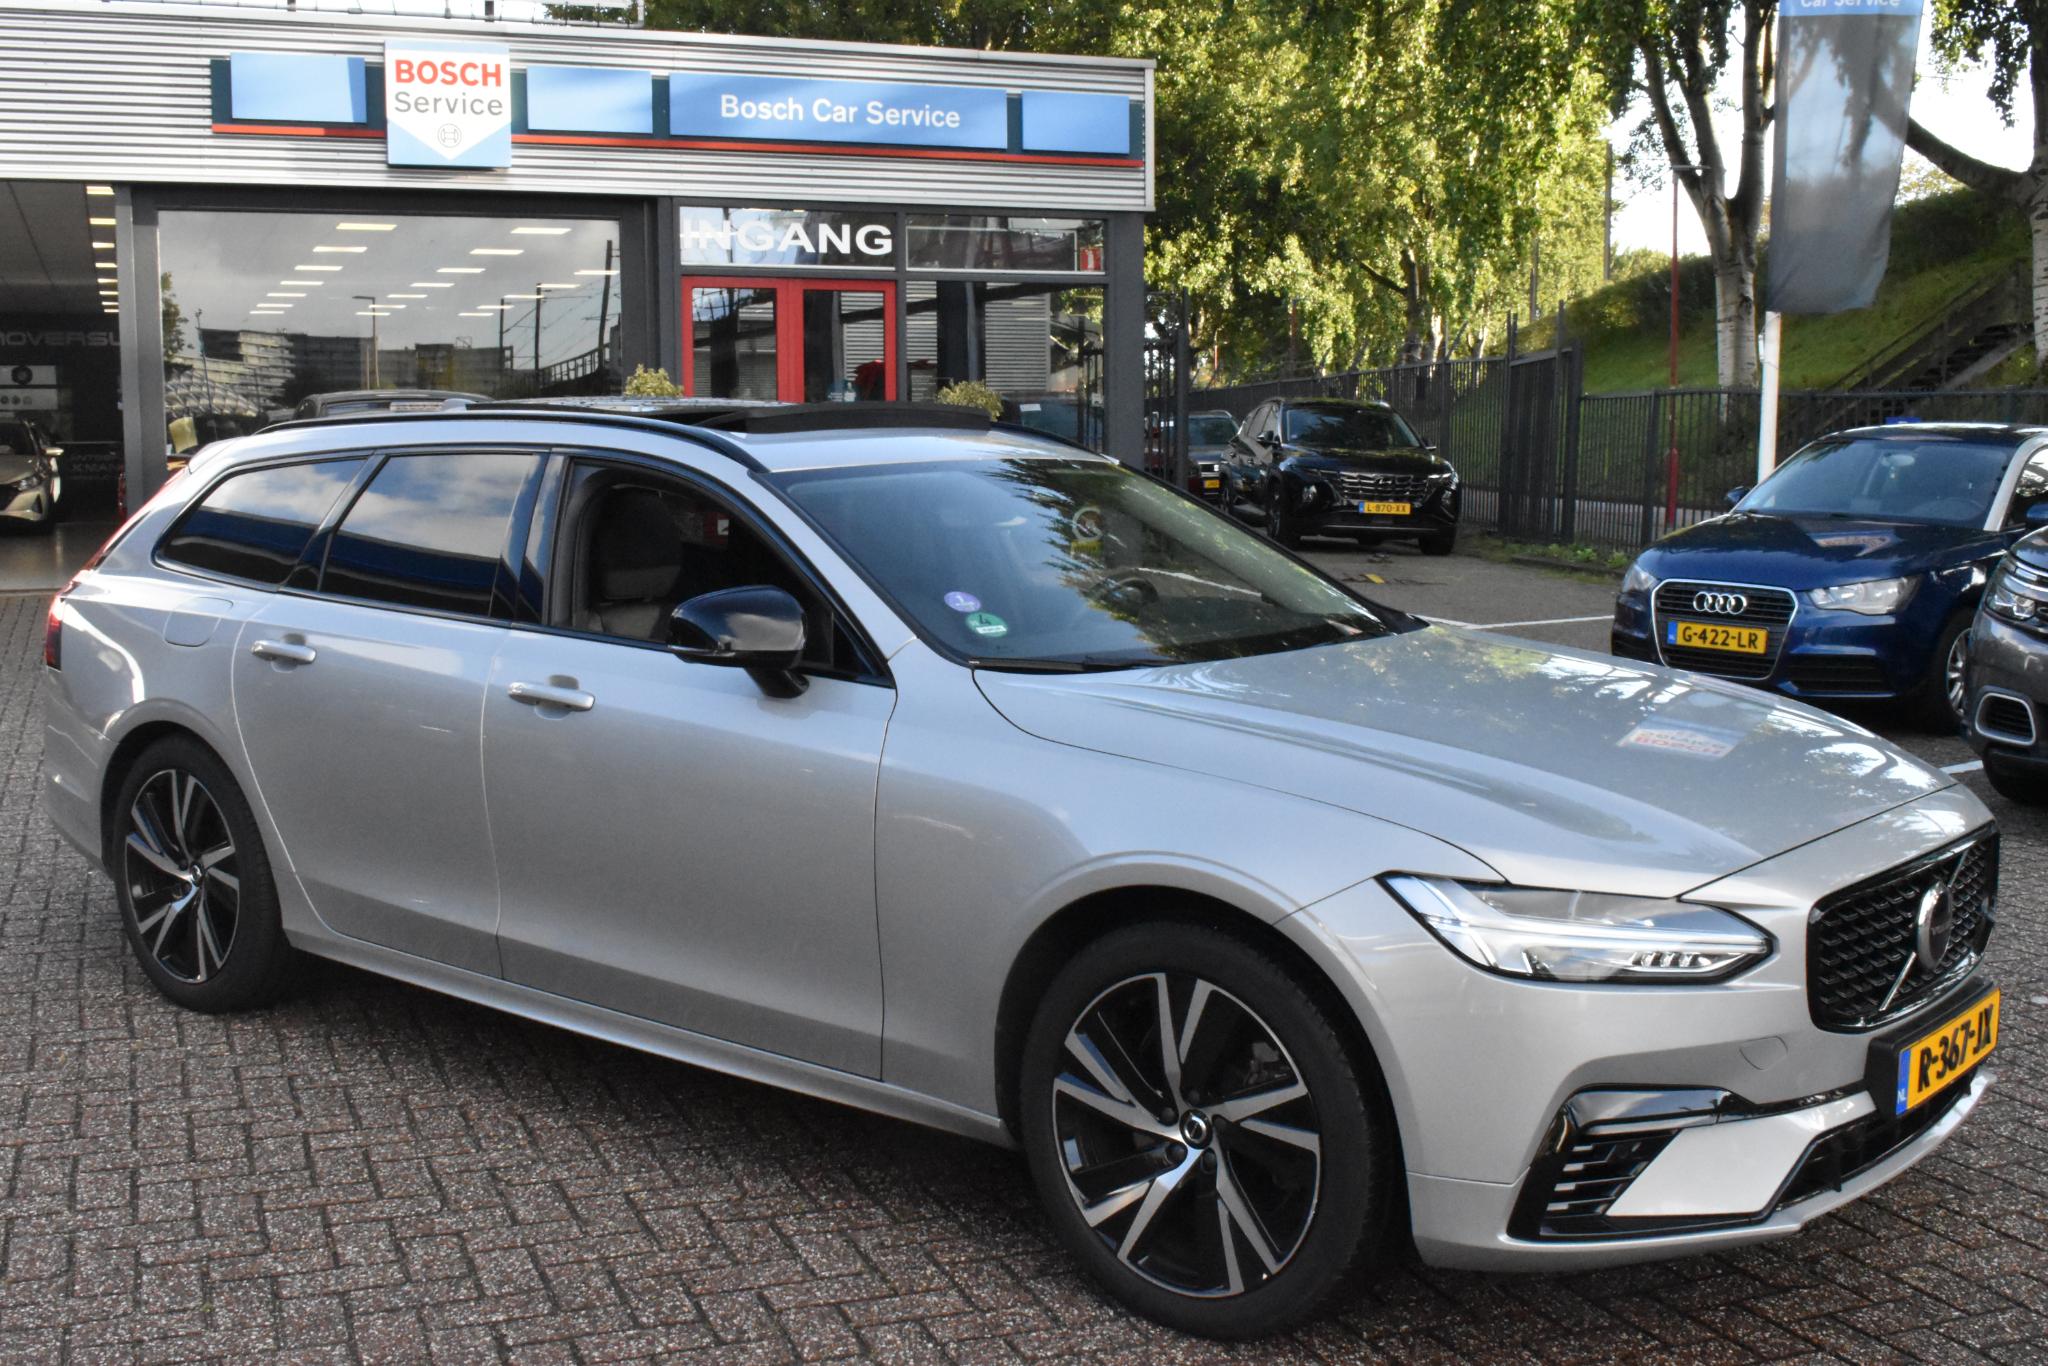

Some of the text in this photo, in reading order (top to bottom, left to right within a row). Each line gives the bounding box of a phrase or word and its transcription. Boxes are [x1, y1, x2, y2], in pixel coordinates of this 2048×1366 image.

[395, 59, 502, 87] BOSCH
[394, 91, 503, 116] Service
[720, 94, 961, 128] Bosch Car Service
[683, 218, 893, 256] INGANG
[1682, 626, 1759, 650] G-422-LR
[1917, 1003, 1994, 1093] R-367-JX
